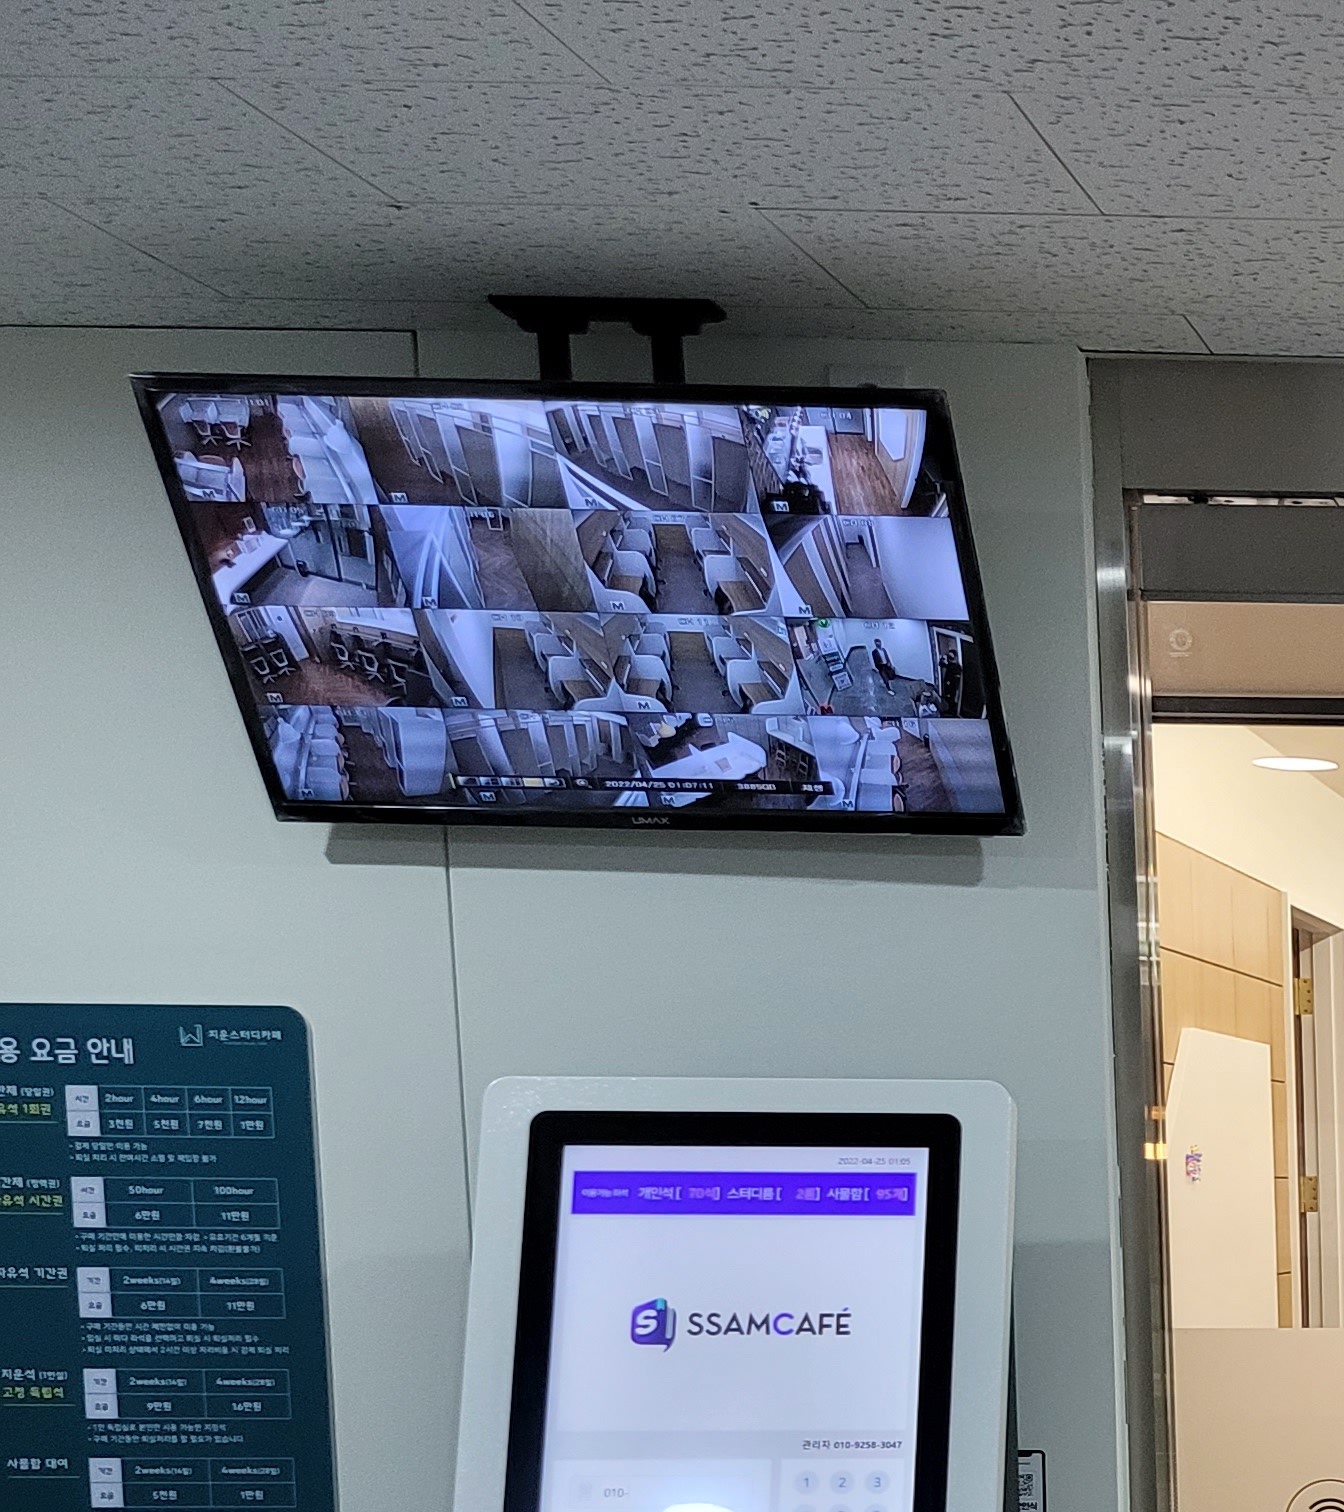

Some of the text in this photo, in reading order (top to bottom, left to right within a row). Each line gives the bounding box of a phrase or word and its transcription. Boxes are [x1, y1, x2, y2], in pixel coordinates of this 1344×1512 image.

[30, 1038, 79, 1064] 요금
[87, 1038, 134, 1064] 안내
[104, 1093, 134, 1103] 2hour
[194, 1095, 223, 1104] 6hour
[128, 1185, 254, 1196] 50hour 100hour
[28, 1194, 64, 1207] 시간권
[33, 1266, 68, 1279] 기간권
[687, 1307, 852, 1336] SSAMCAFÉ
[1, 1368, 36, 1381] 지운석
[802, 1439, 903, 1451] 관리자 010-9258-3047
[7, 1457, 69, 1470] 사물함 대여
